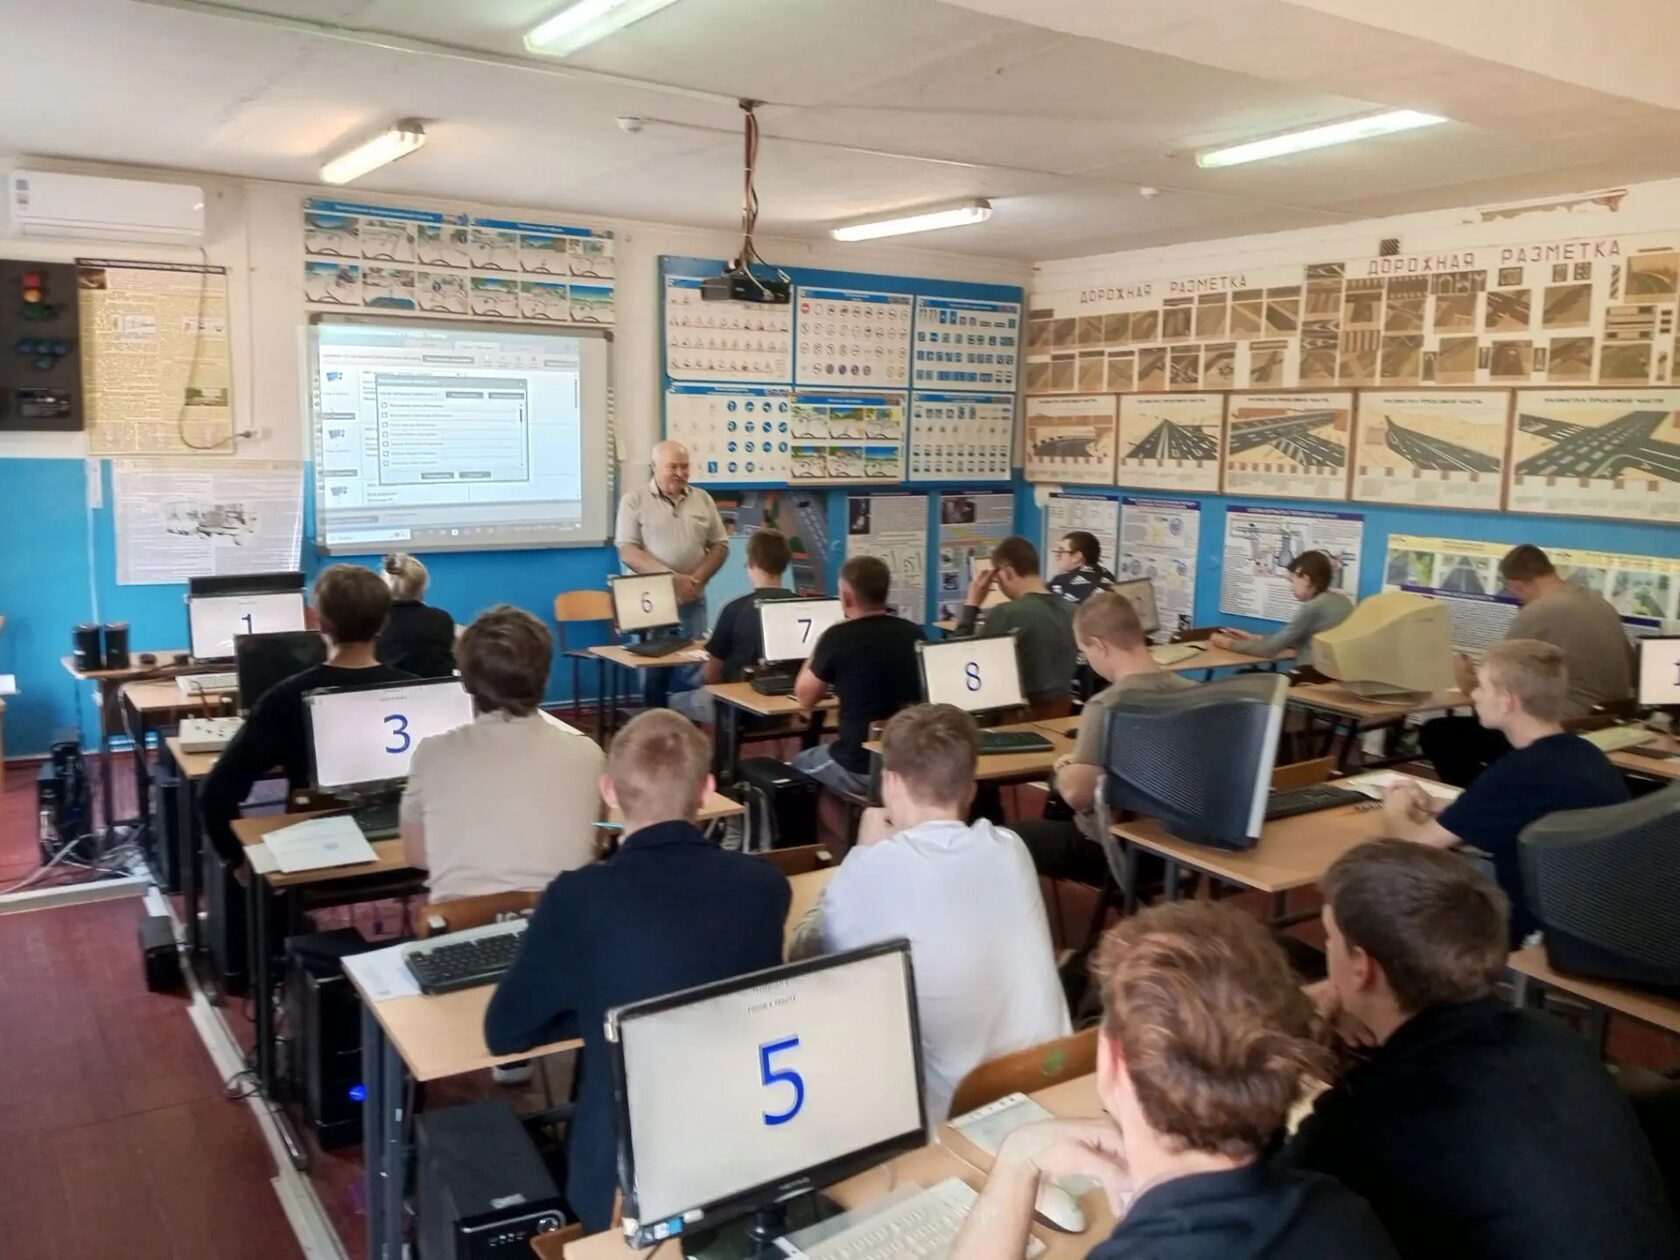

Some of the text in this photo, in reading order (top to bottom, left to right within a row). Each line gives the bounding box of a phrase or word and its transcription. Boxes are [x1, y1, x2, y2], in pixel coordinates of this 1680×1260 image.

[1368, 239, 1621, 276] ДОРОЖНАЯ РАЗМЕТКА
[1079, 274, 1247, 304] ДОРОЖНАЯ РАЗМЕТКА
[640, 591, 653, 614] 6
[241, 613, 253, 634] 1
[797, 618, 812, 643] 7
[965, 661, 982, 692] 8
[383, 713, 411, 754] 3
[758, 1033, 805, 1126] 5
